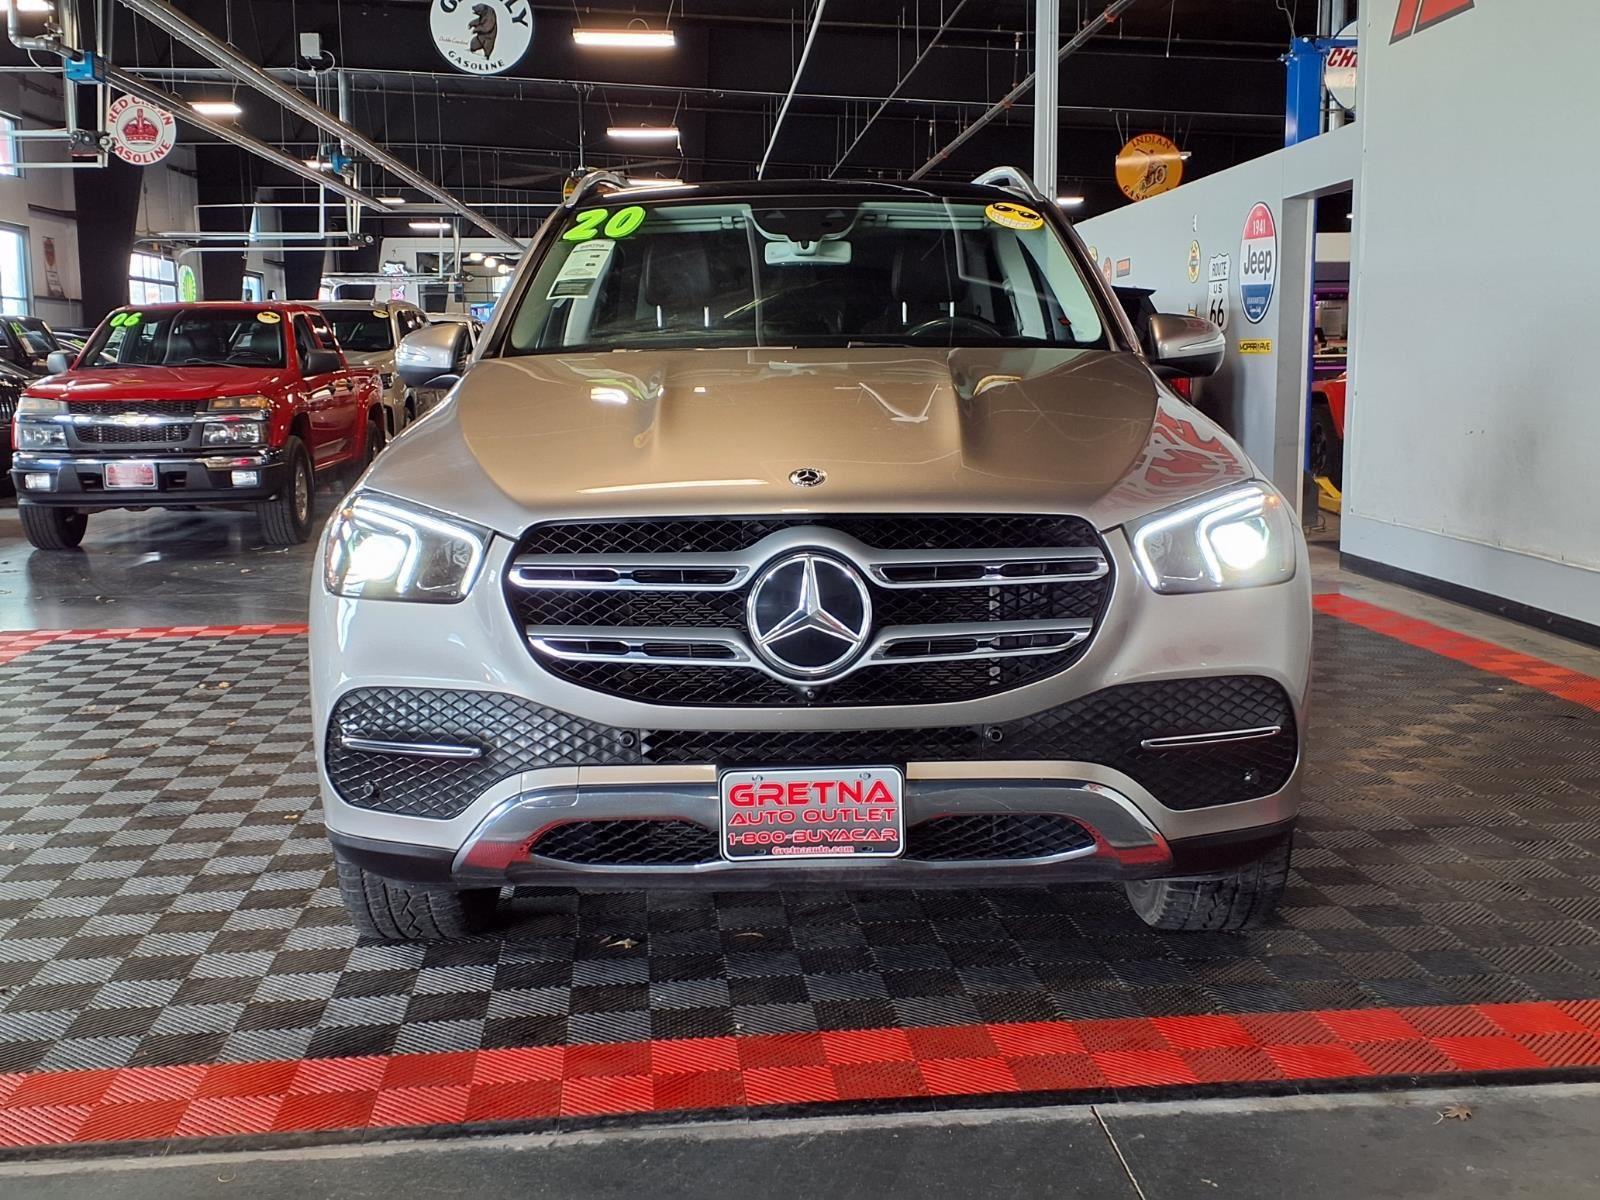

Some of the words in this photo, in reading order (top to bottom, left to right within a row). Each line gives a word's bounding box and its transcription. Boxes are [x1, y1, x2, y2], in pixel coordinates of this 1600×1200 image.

[448, 50, 505, 70] GASOLINE
[109, 99, 128, 123] RED
[1131, 136, 1172, 149] INDIAN
[562, 206, 646, 241] 20
[1253, 219, 1266, 236] 1941
[1212, 261, 1226, 276] ROUTE
[1244, 245, 1271, 280] Jeep
[1213, 284, 1222, 294] US
[110, 312, 142, 327] 06
[1210, 299, 1224, 327] 66
[728, 780, 896, 807] GRETNA
[728, 809, 796, 826] AUTO
[802, 808, 897, 823] OUTLET
[728, 828, 898, 845] 1-800-BUYACAR
[771, 844, 855, 855] Gretnaauto.com
